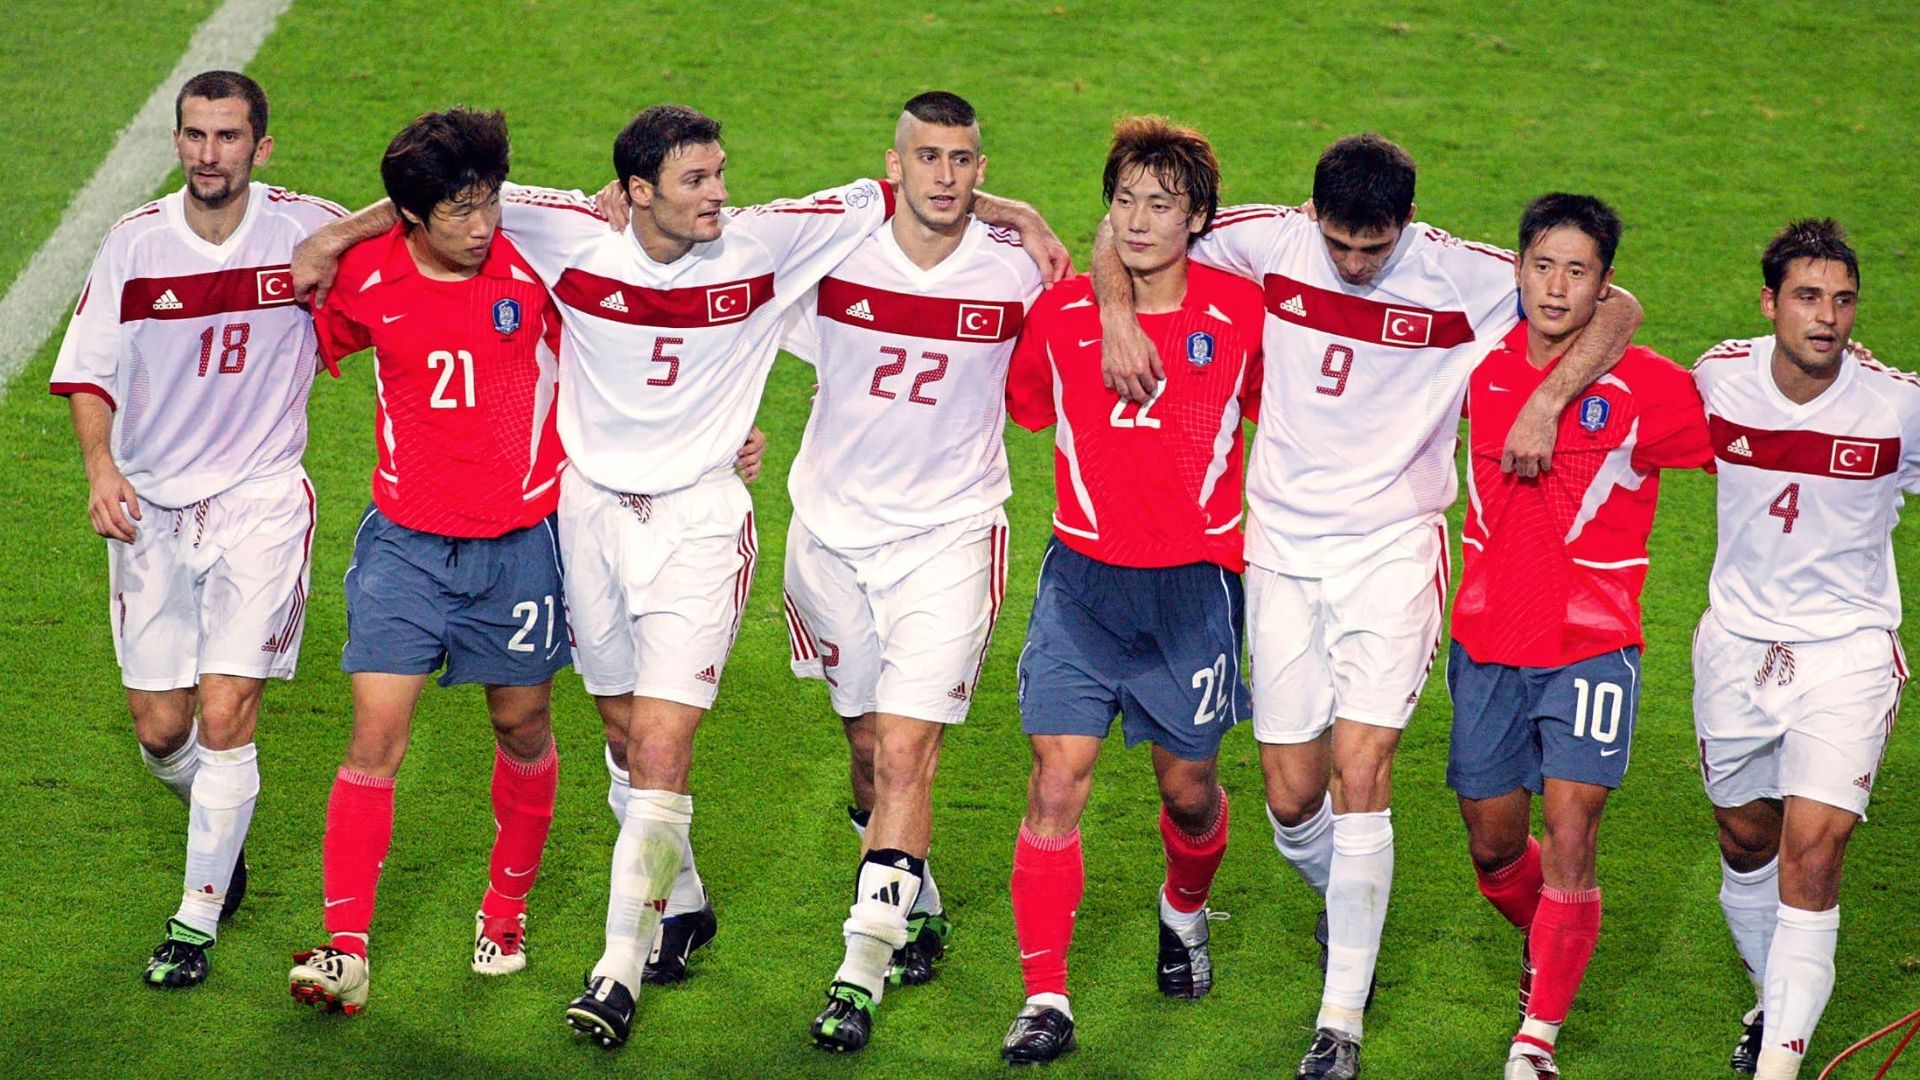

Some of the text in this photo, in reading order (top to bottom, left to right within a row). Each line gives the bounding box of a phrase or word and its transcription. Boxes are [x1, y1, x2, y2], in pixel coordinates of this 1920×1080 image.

[152, 301, 183, 310] adidas
[599, 300, 629, 313] adidas
[845, 308, 875, 321] adidas
[1280, 302, 1307, 317] adidas
[197, 322, 250, 377] 18
[646, 336, 684, 387] 5
[869, 346, 949, 406] 22
[1316, 343, 1354, 397] 9
[427, 349, 476, 409] 21
[1727, 444, 1753, 457] adidas
[1768, 482, 1800, 534] 4
[507, 594, 554, 652] 21
[1192, 653, 1227, 726] 22
[1573, 678, 1623, 744] 10
